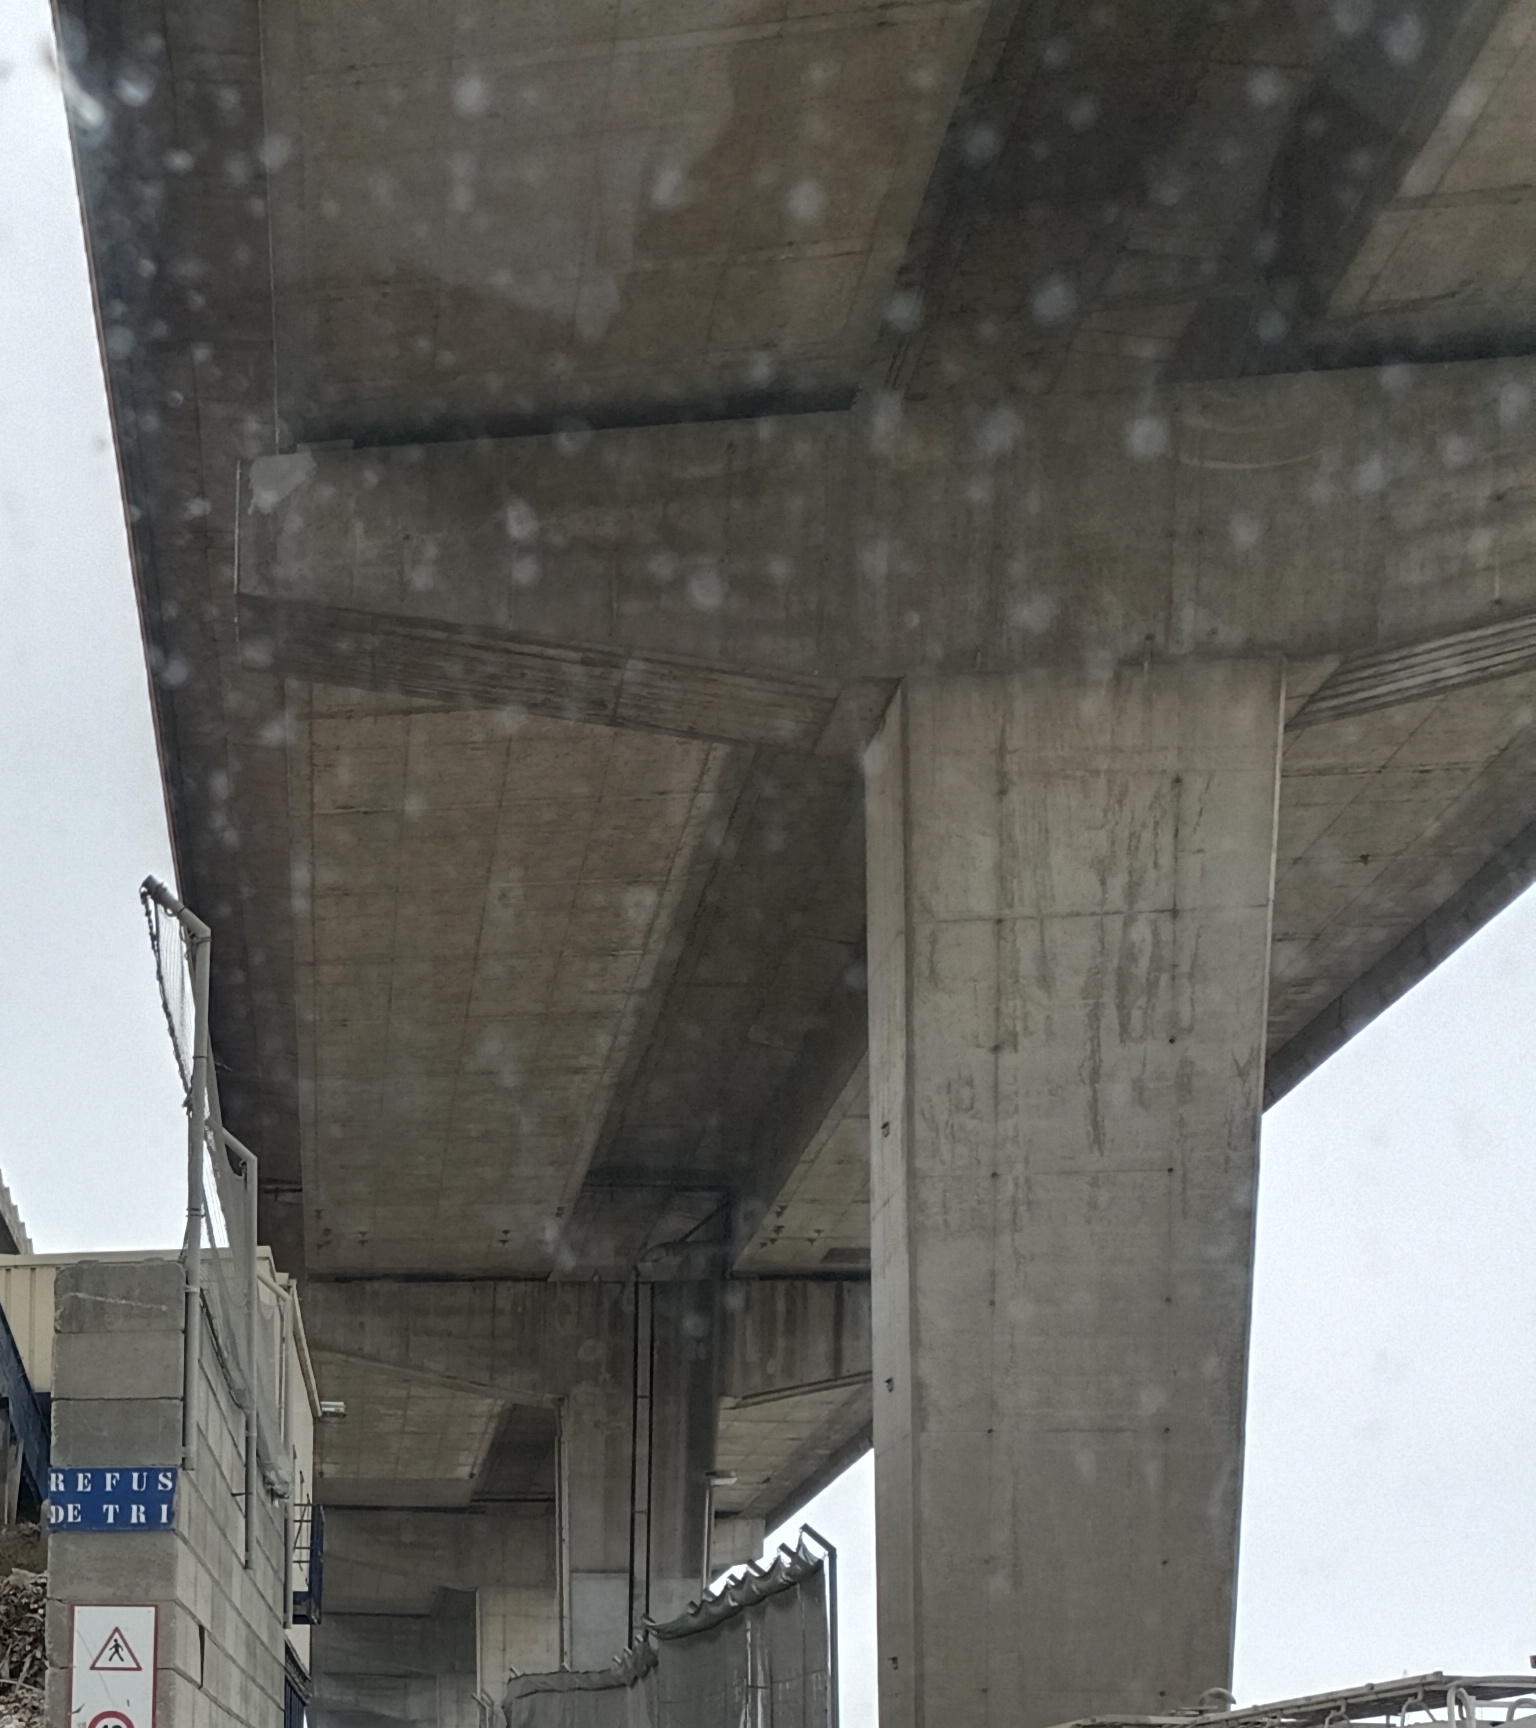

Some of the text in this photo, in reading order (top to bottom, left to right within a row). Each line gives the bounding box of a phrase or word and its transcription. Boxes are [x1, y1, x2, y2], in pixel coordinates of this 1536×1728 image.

[50, 1472, 173, 1492] REFUS
[50, 1503, 169, 1524] DE TRI
